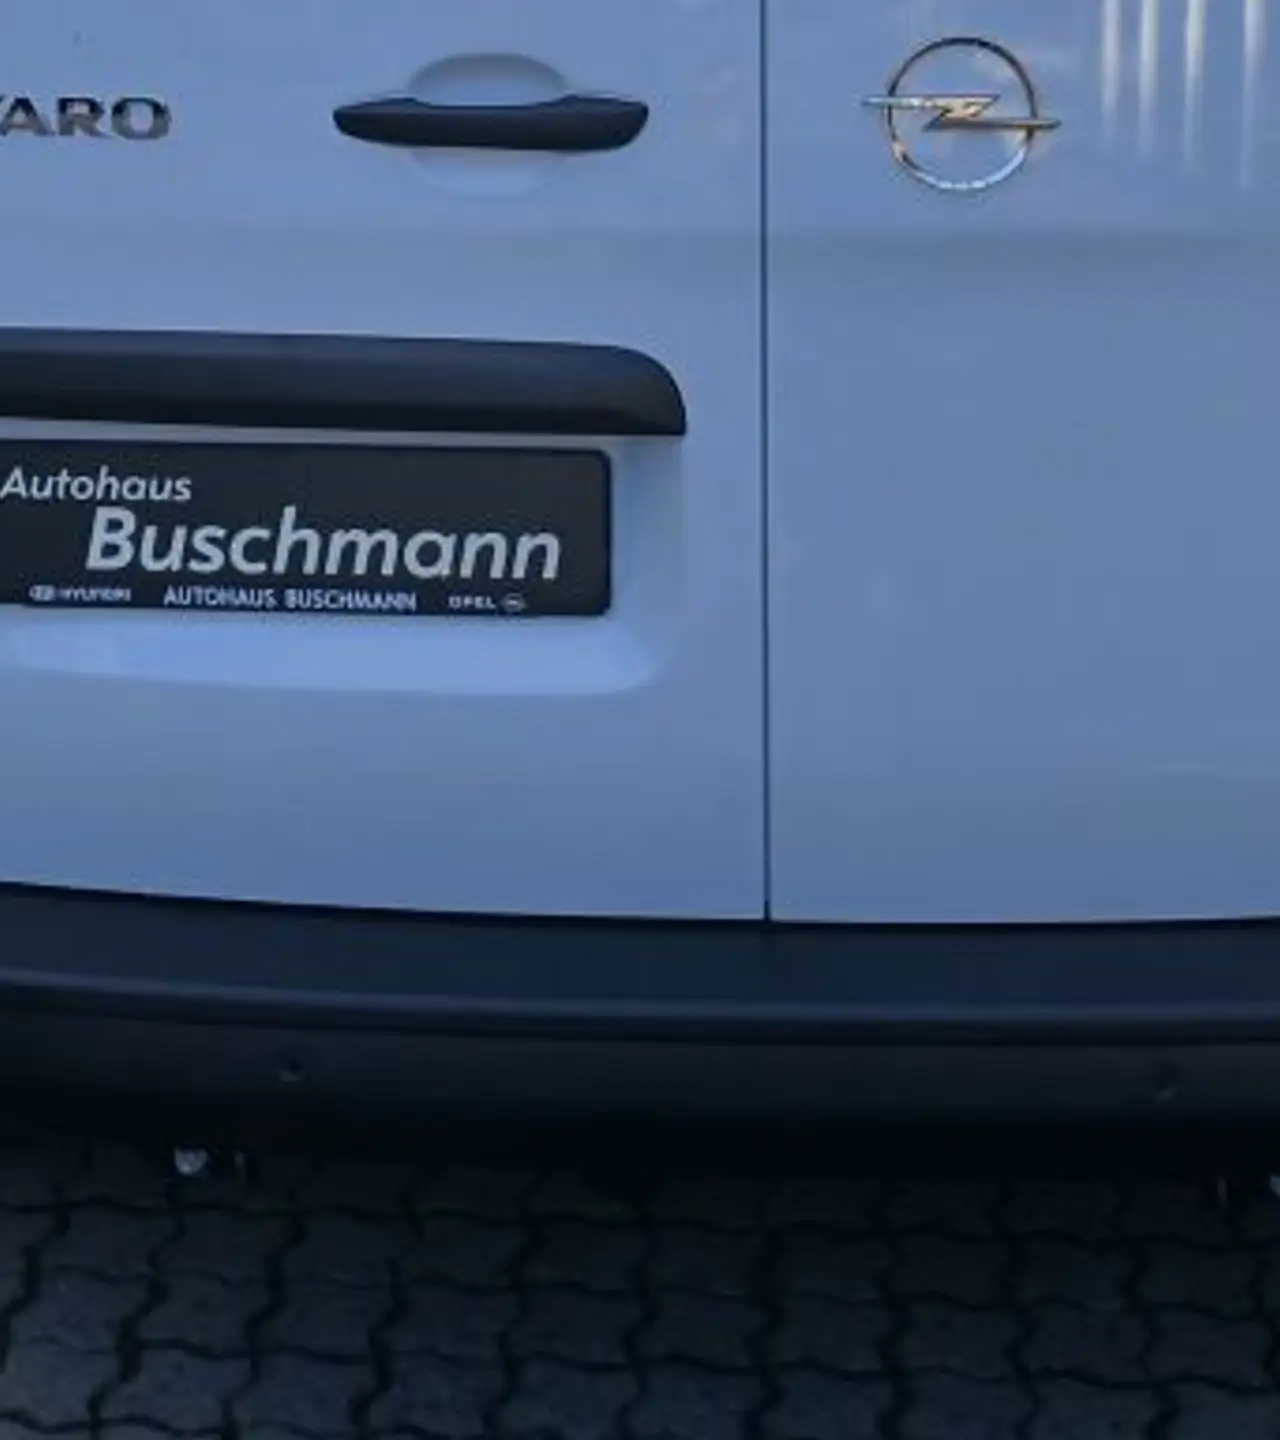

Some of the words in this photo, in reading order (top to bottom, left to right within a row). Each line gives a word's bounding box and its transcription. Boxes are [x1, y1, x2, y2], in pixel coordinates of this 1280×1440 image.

[85, 505, 561, 581] Buschmann
[163, 584, 278, 608] AUTOHAUS
[283, 588, 417, 611] BUSCHMANN
[448, 595, 497, 609] OPEL
